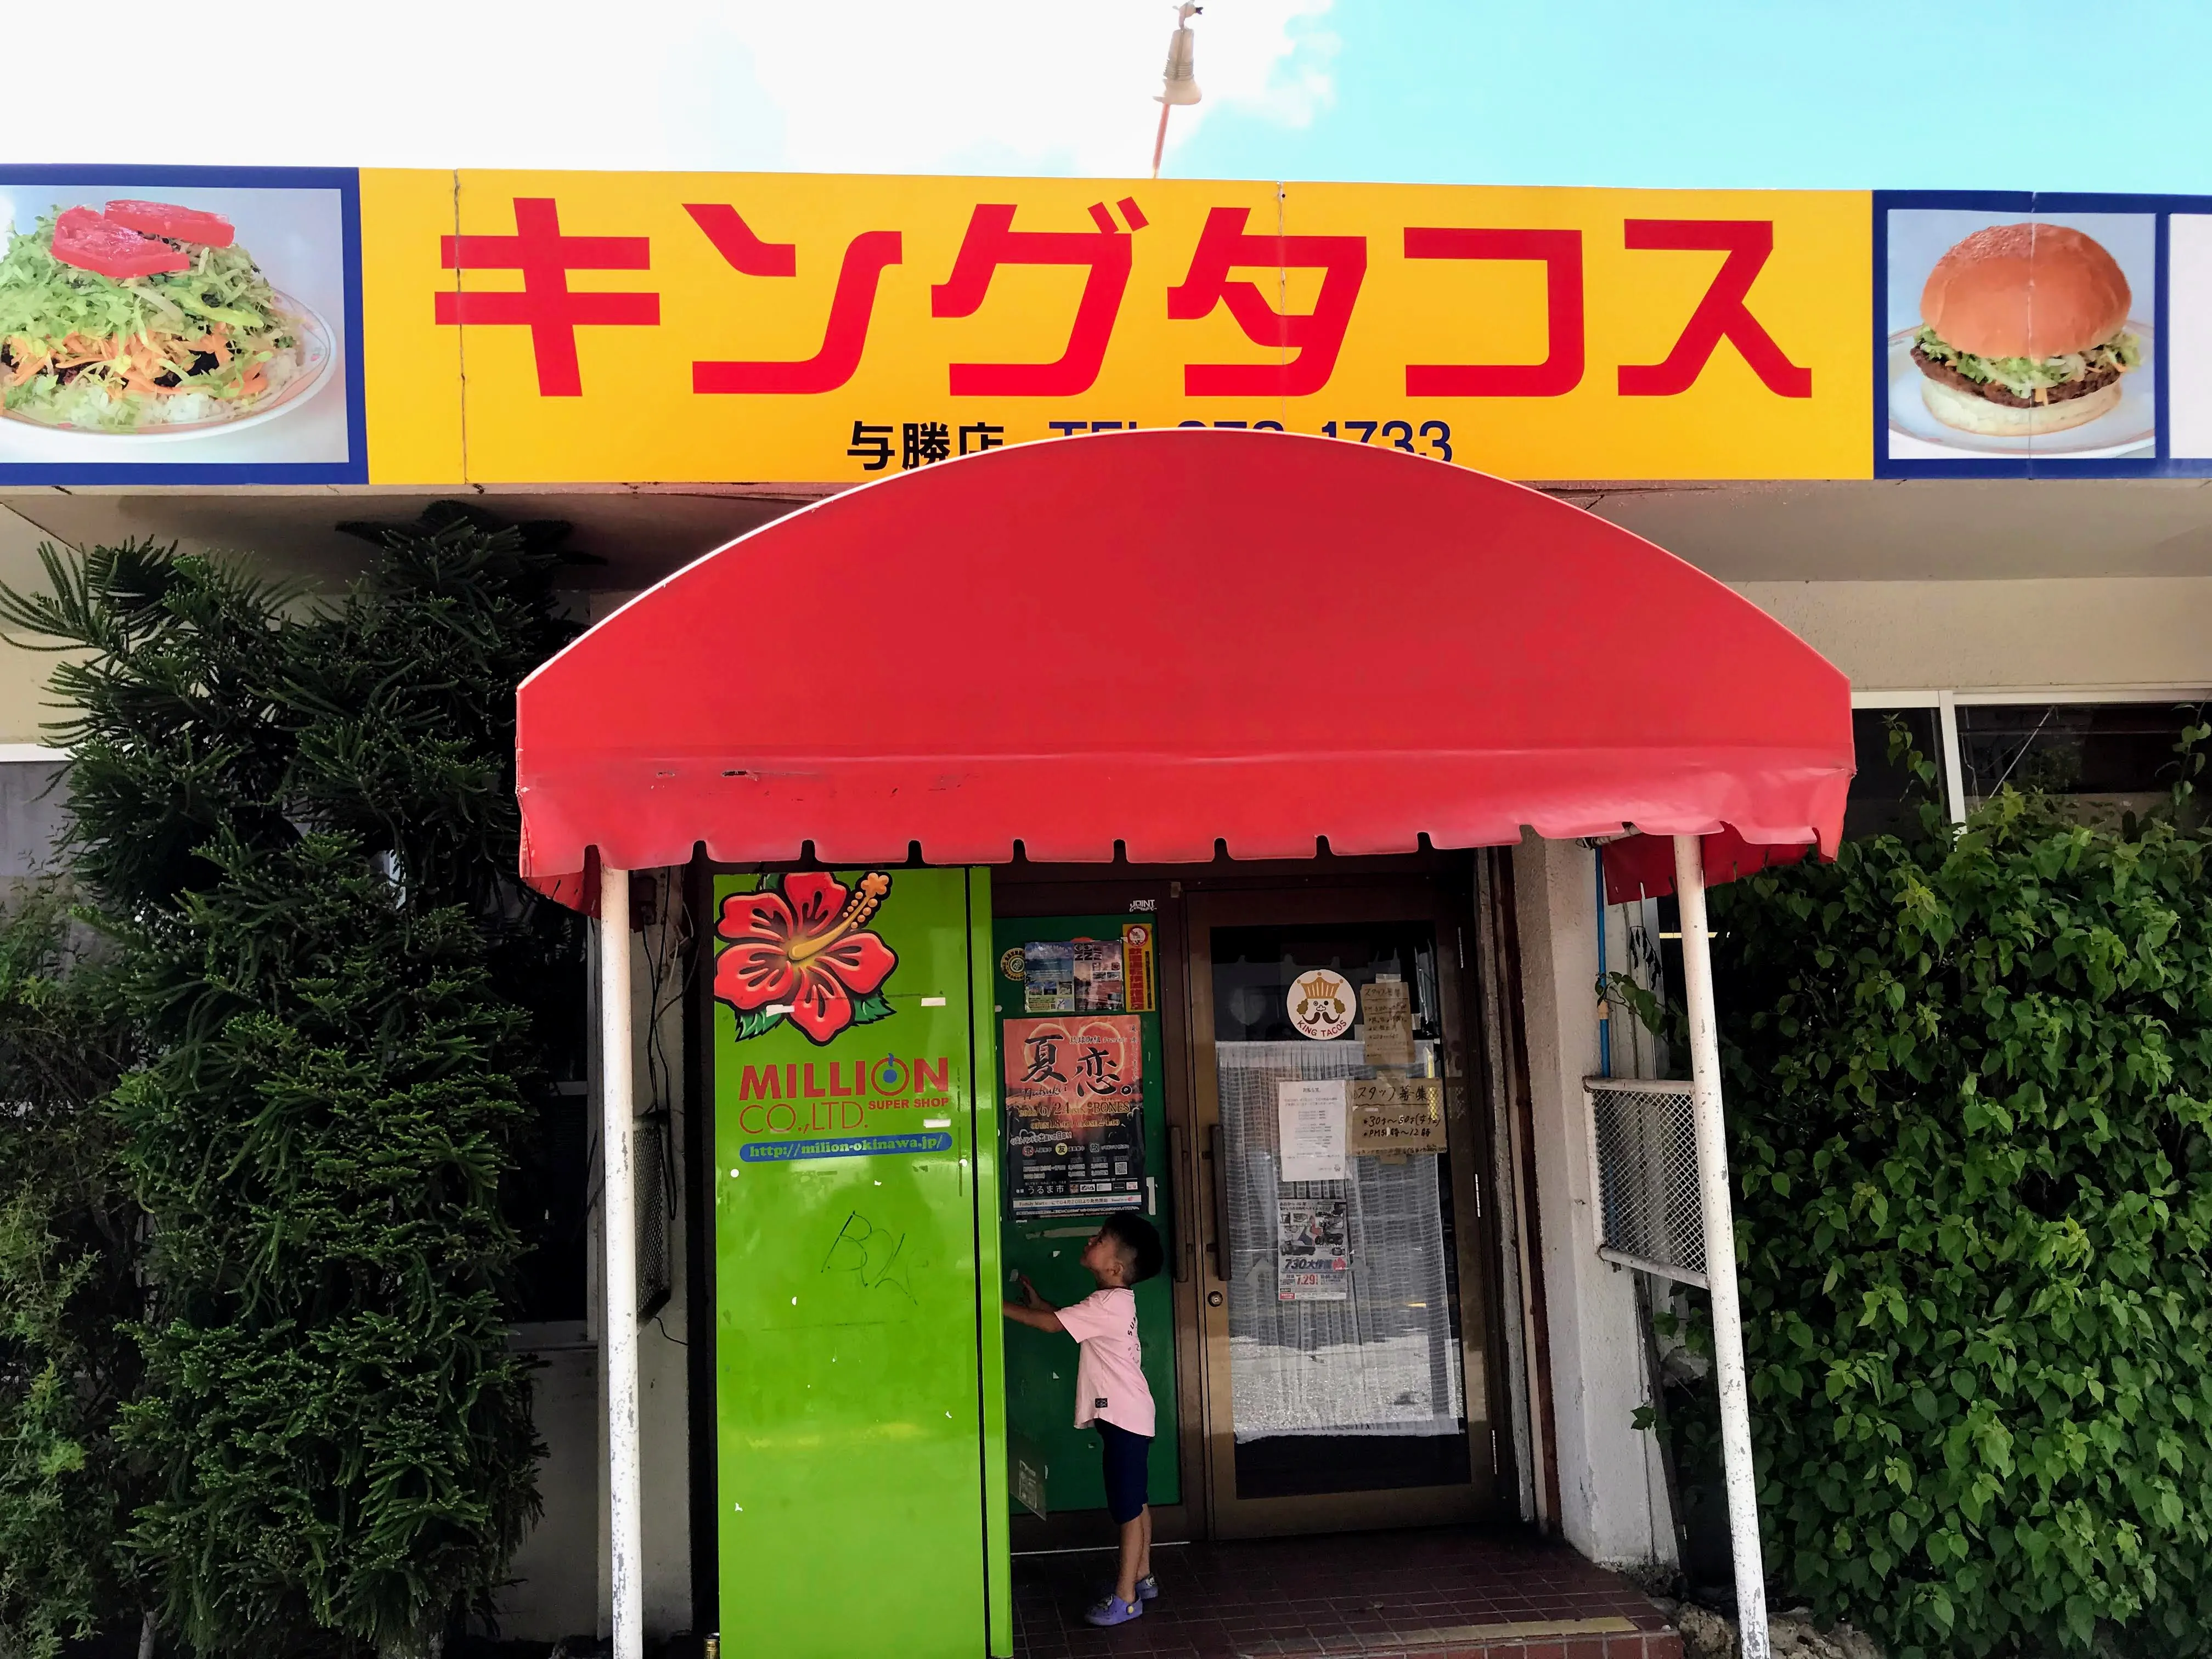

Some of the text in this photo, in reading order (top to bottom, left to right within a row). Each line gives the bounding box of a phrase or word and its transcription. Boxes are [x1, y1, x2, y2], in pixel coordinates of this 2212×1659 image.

[435, 196, 1812, 397] キングタコス
[1297, 1019, 1347, 1037] KING TACOS
[739, 1055, 949, 1101] MILLION
[868, 1098, 949, 1110] SUPER SHOP
[739, 1101, 869, 1135] CO.,LTD.
[1028, 1184, 1064, 1194] うるま市
